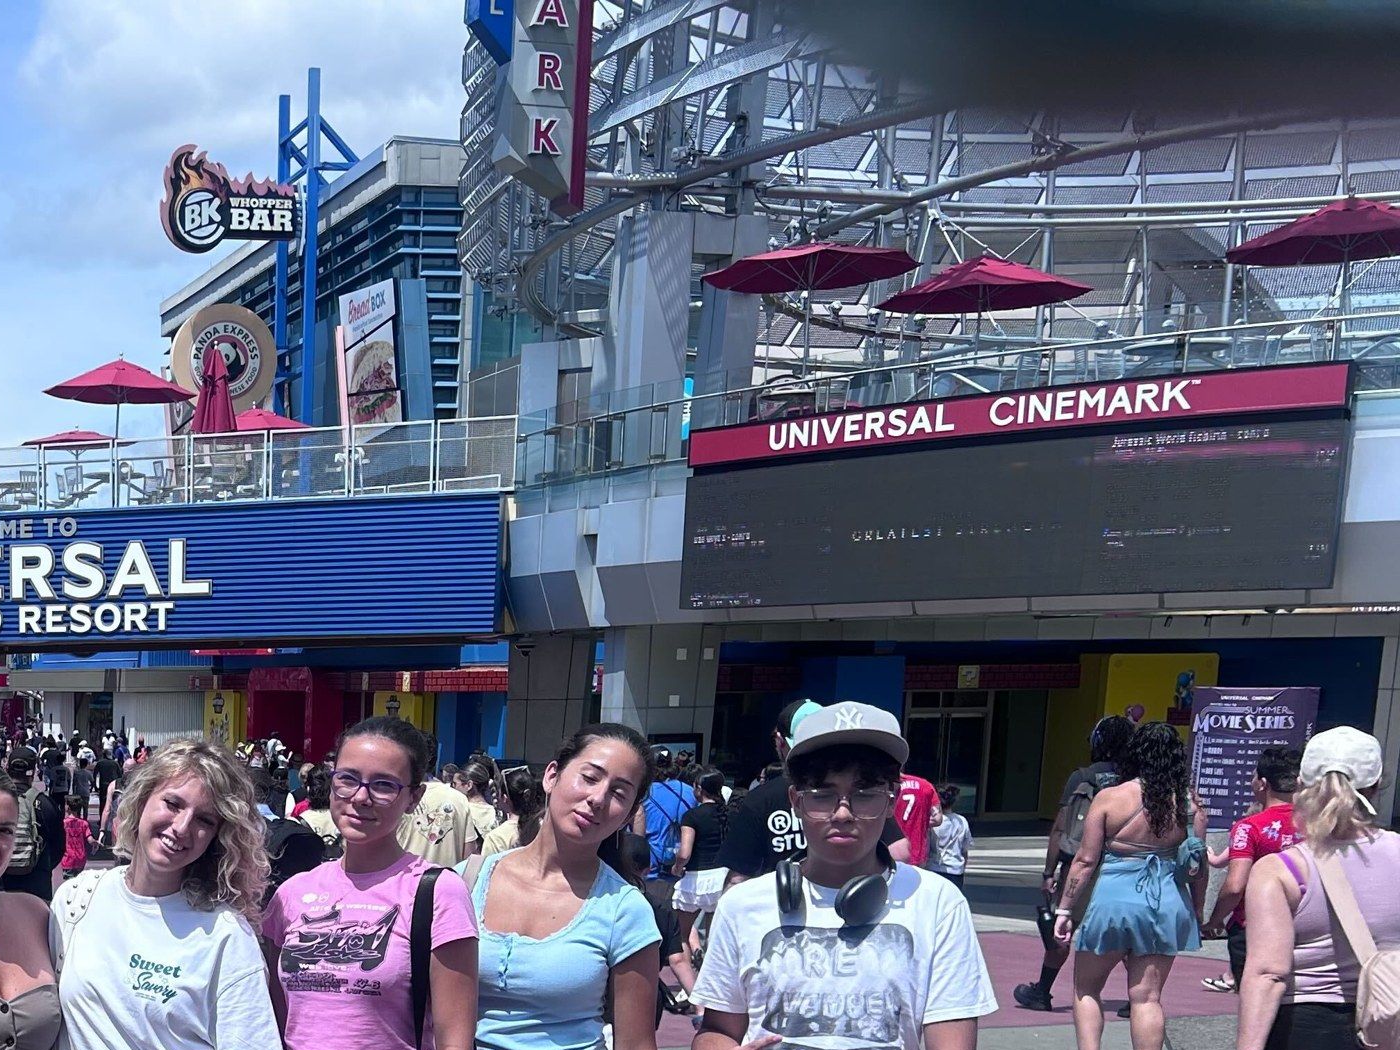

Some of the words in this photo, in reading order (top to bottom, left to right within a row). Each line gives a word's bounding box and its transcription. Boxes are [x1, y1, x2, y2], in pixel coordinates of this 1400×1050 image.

[184, 197, 222, 233] BK
[229, 196, 293, 209] WHOPPER
[229, 208, 293, 232] BAR
[193, 326, 220, 361] PANDA
[223, 324, 259, 361] EXPRESS
[245, 365, 258, 386] FOOD
[768, 407, 955, 451] UNIVERSAL
[43, 516, 78, 538] TO
[18, 601, 175, 634] RESORT
[1244, 705, 1290, 715] SUMMER
[1192, 713, 1243, 733] MOVIE
[1243, 714, 1296, 734] SERIES
[902, 793, 916, 821] 7
[129, 953, 182, 979] Sweet
[132, 971, 178, 1005] Savory
